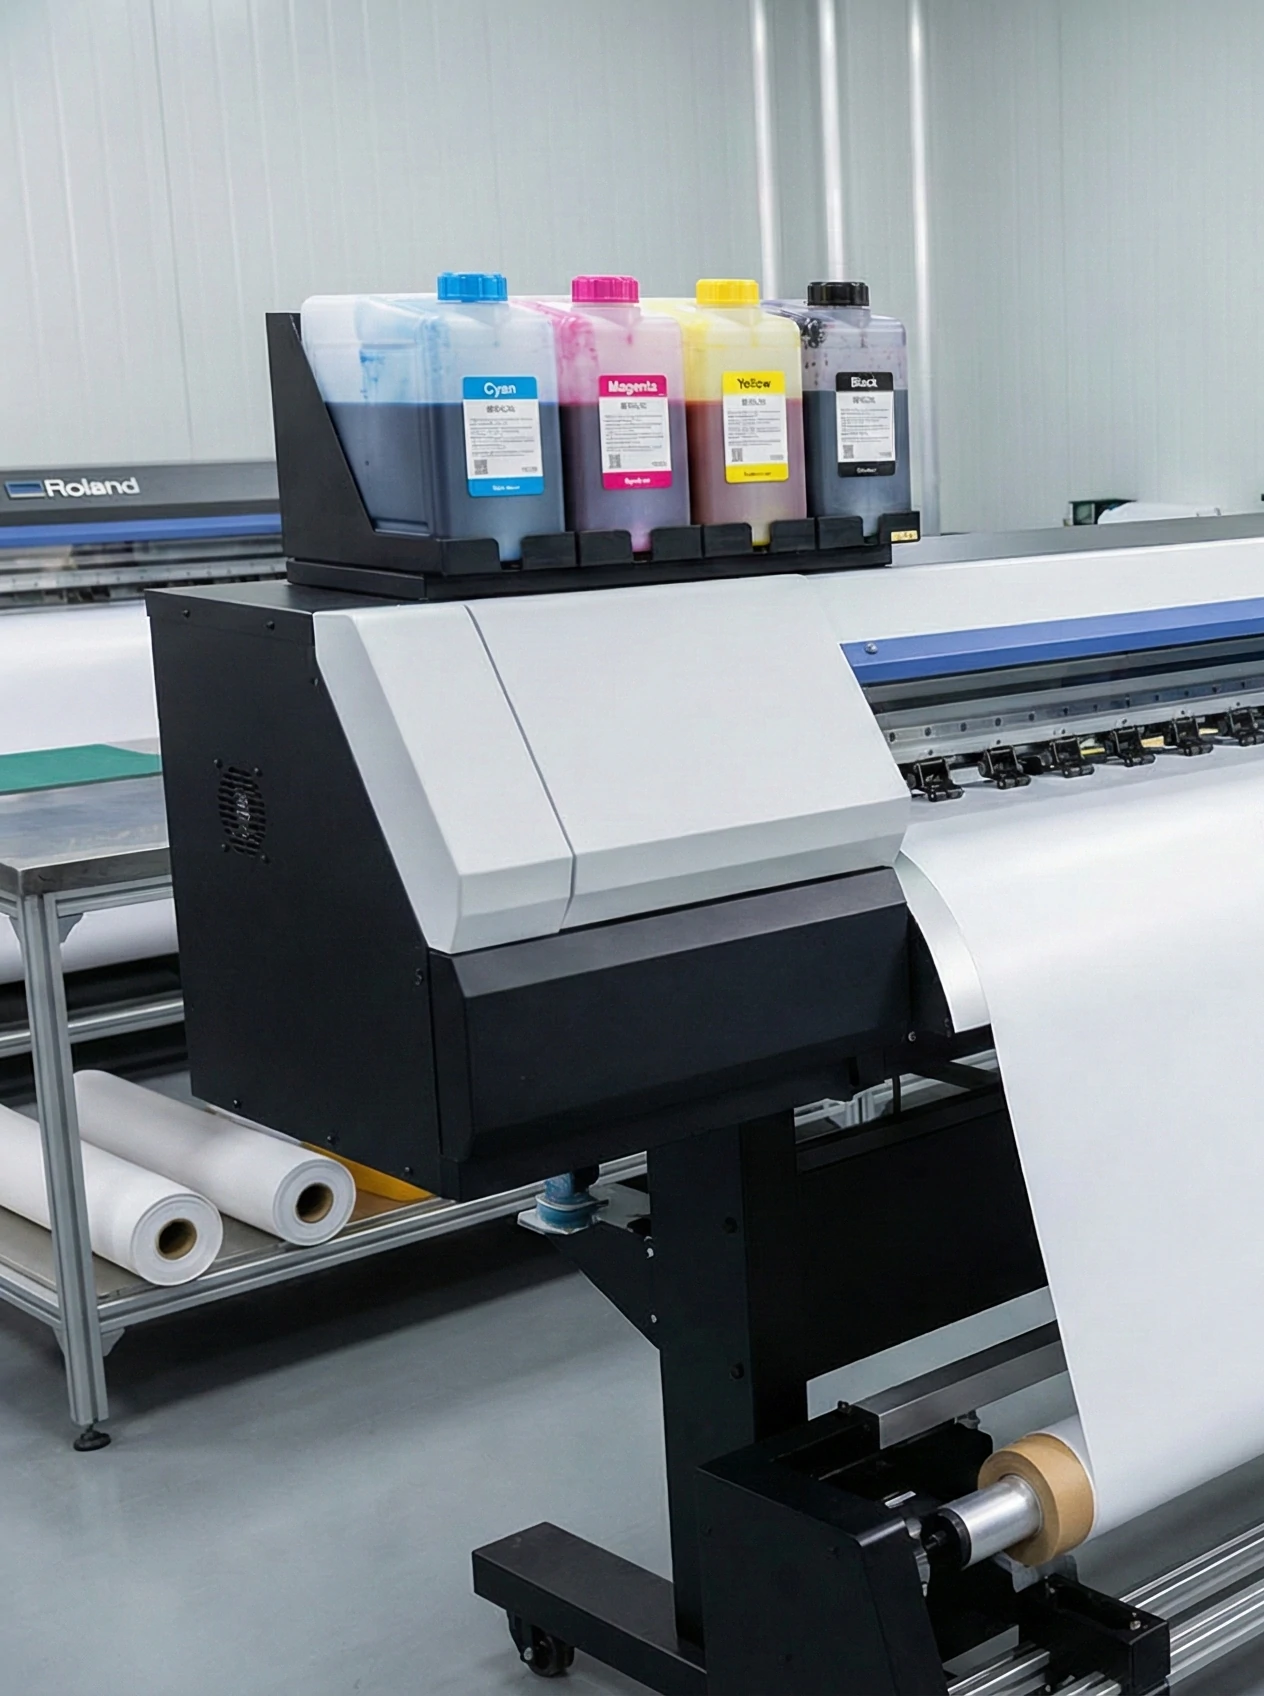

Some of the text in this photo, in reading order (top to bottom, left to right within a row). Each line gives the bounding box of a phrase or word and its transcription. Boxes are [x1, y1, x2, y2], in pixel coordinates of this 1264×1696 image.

[483, 381, 517, 398] Cyan
[608, 380, 658, 396] Magenta
[44, 477, 140, 497] Roland
